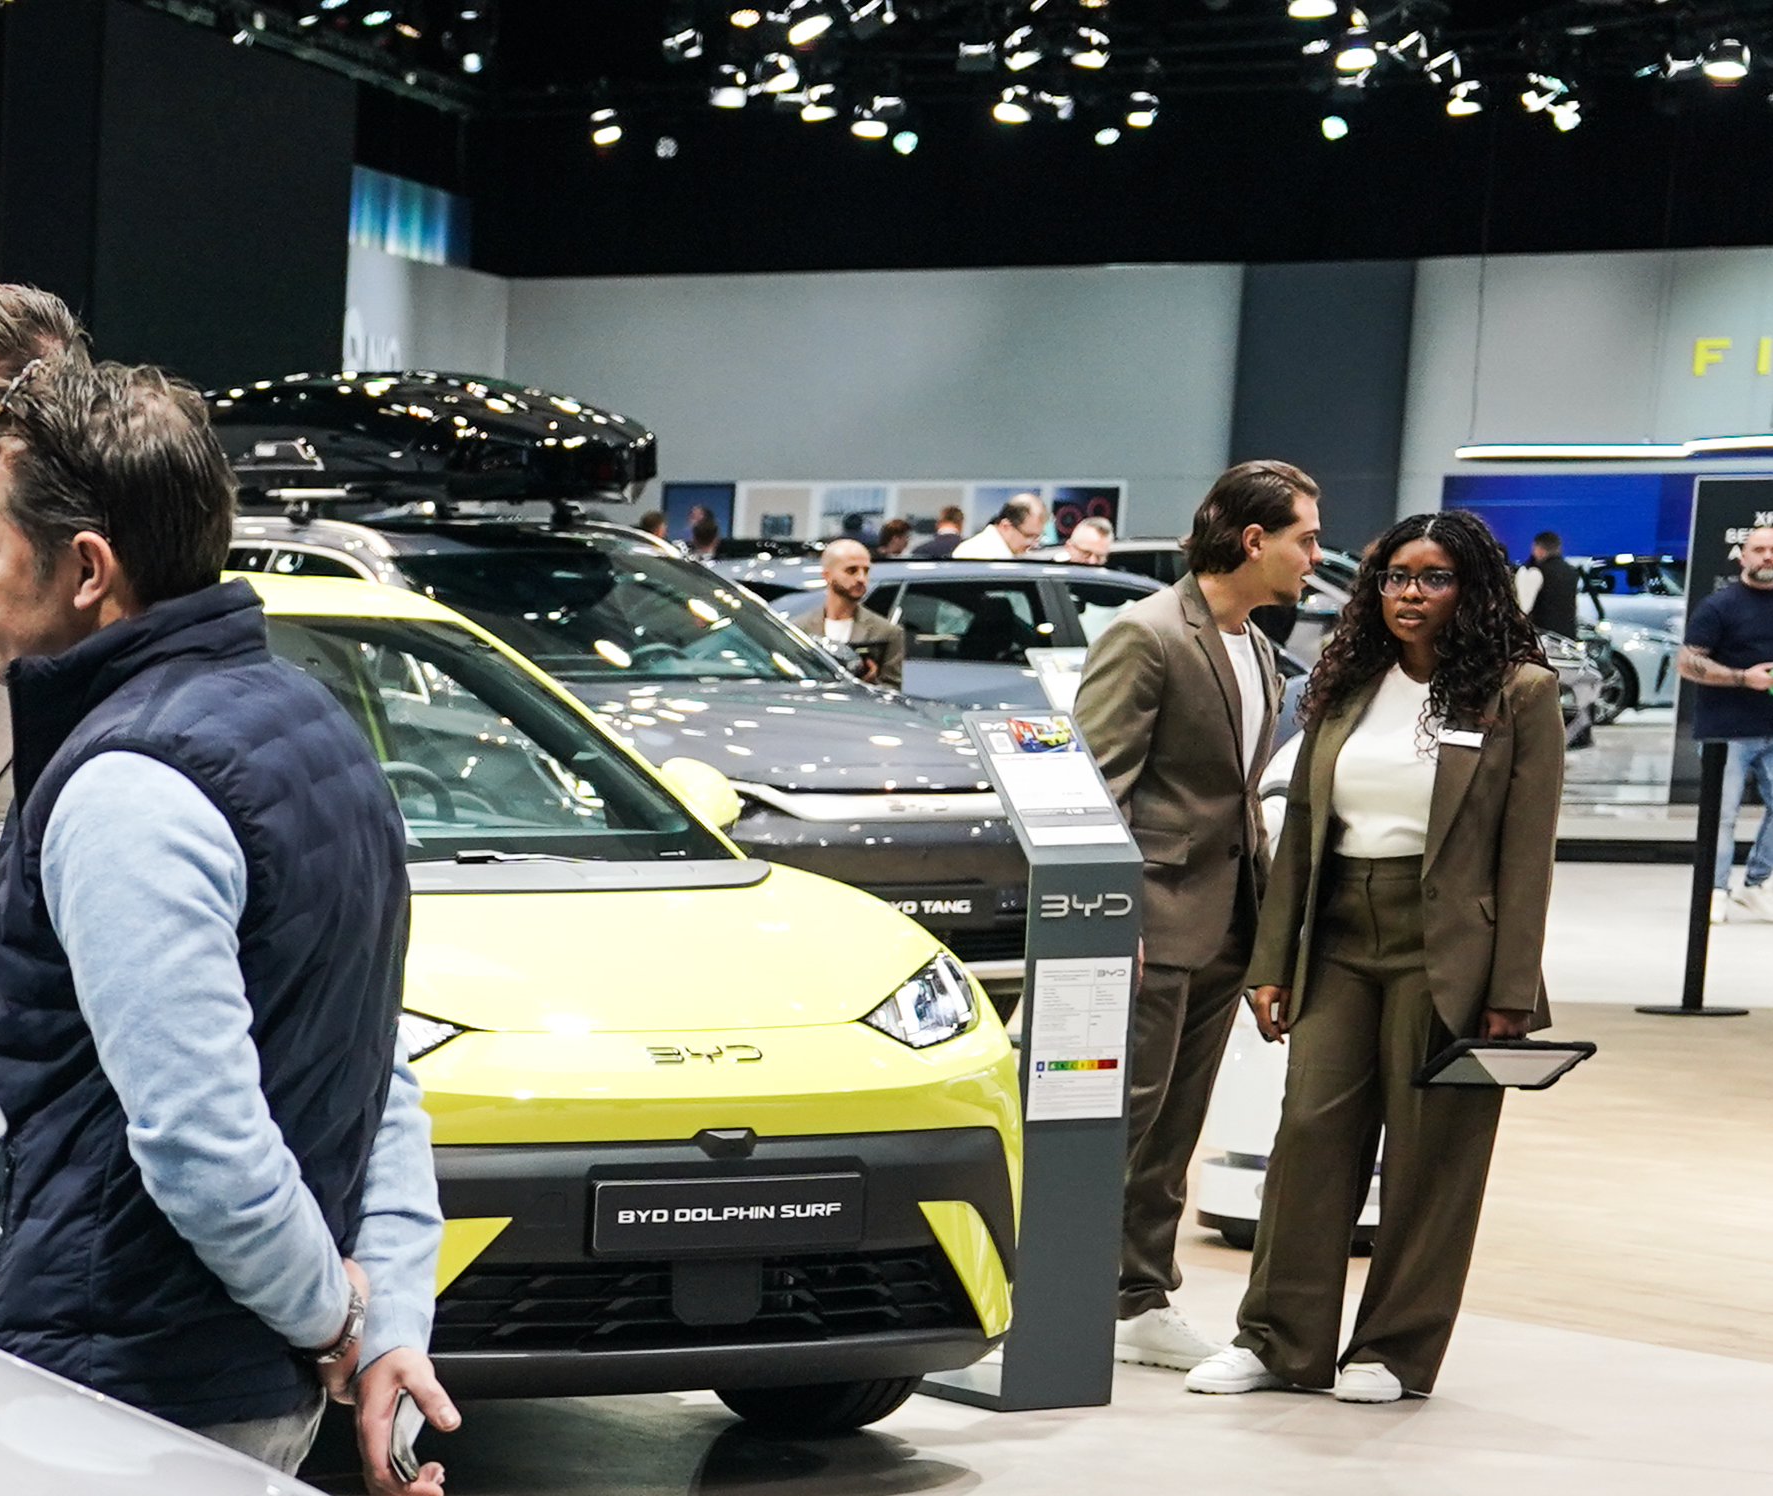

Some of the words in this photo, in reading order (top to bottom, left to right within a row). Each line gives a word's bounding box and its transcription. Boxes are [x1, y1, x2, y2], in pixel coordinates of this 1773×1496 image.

[921, 900, 972, 913] TANG
[1040, 893, 1133, 918] BYD
[1097, 969, 1127, 977] BYD
[643, 1045, 763, 1065] BYD
[618, 1210, 668, 1224] BYD
[674, 1205, 775, 1222] DOLPHIN
[780, 1202, 842, 1219] SURF
